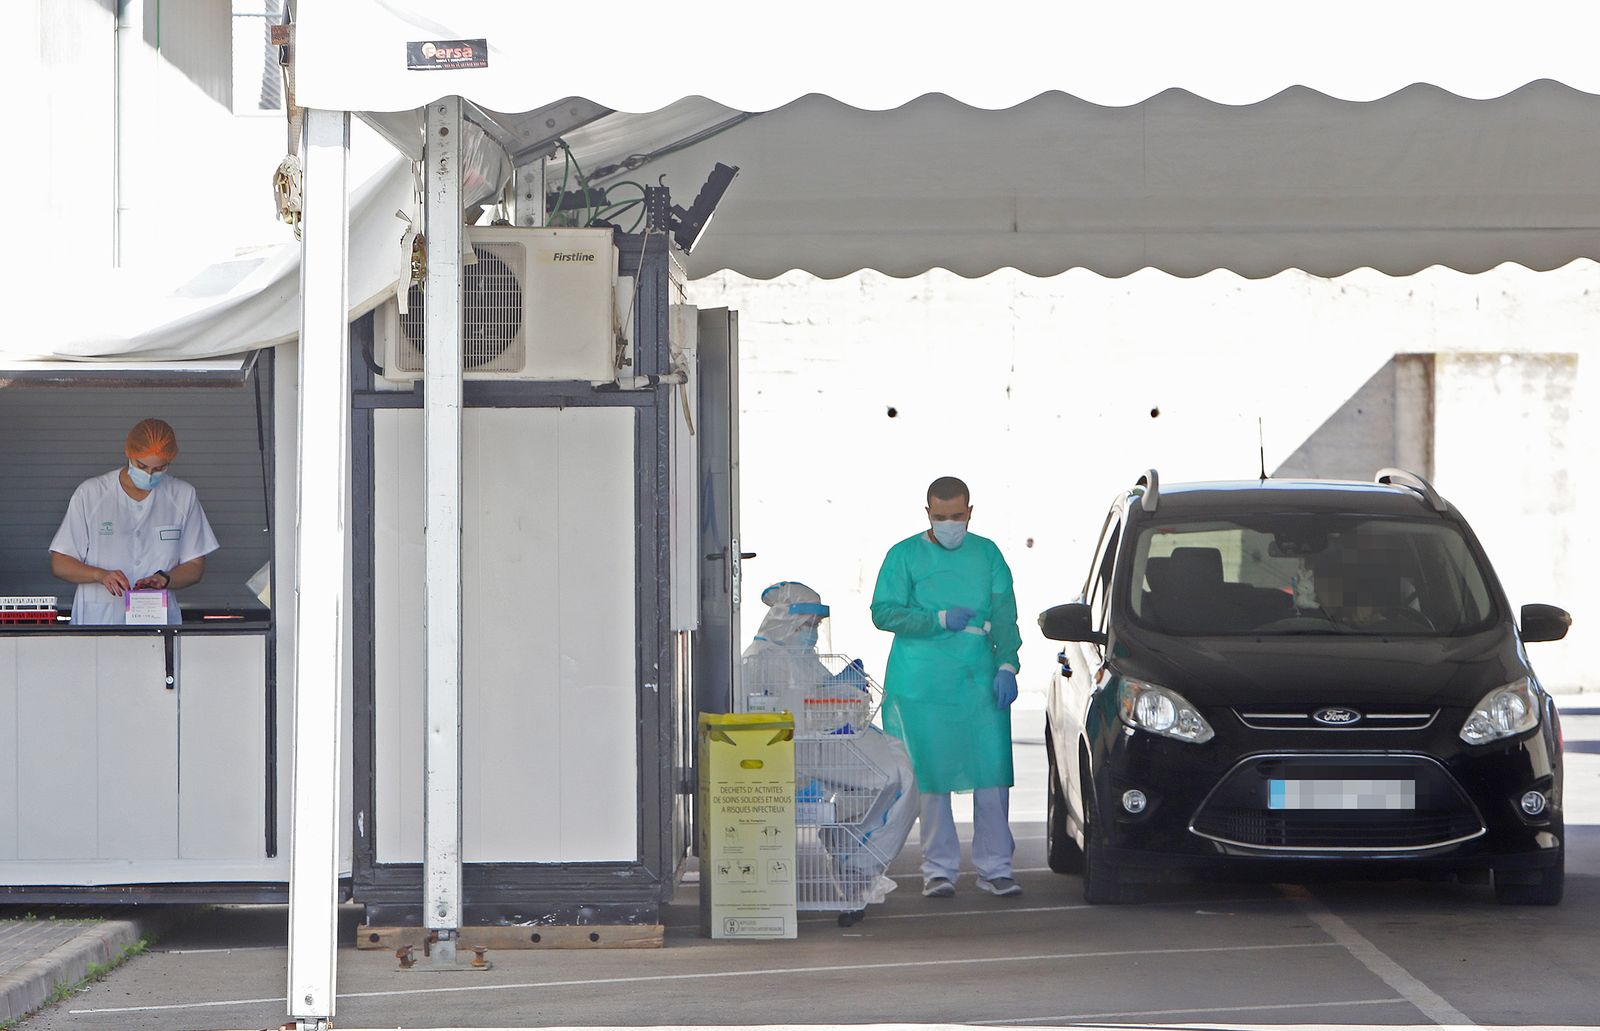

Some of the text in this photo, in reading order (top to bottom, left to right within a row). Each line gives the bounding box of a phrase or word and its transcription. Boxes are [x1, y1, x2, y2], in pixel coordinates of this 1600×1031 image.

[553, 252, 595, 261] Firstline
[1324, 710, 1350, 721] Ford
[720, 786, 746, 794] DECHETS
[754, 786, 784, 794] ACTIVITES
[713, 796, 792, 804] DE SOINS SOLIDES ET MOUS
[726, 806, 751, 814] RISQUES
